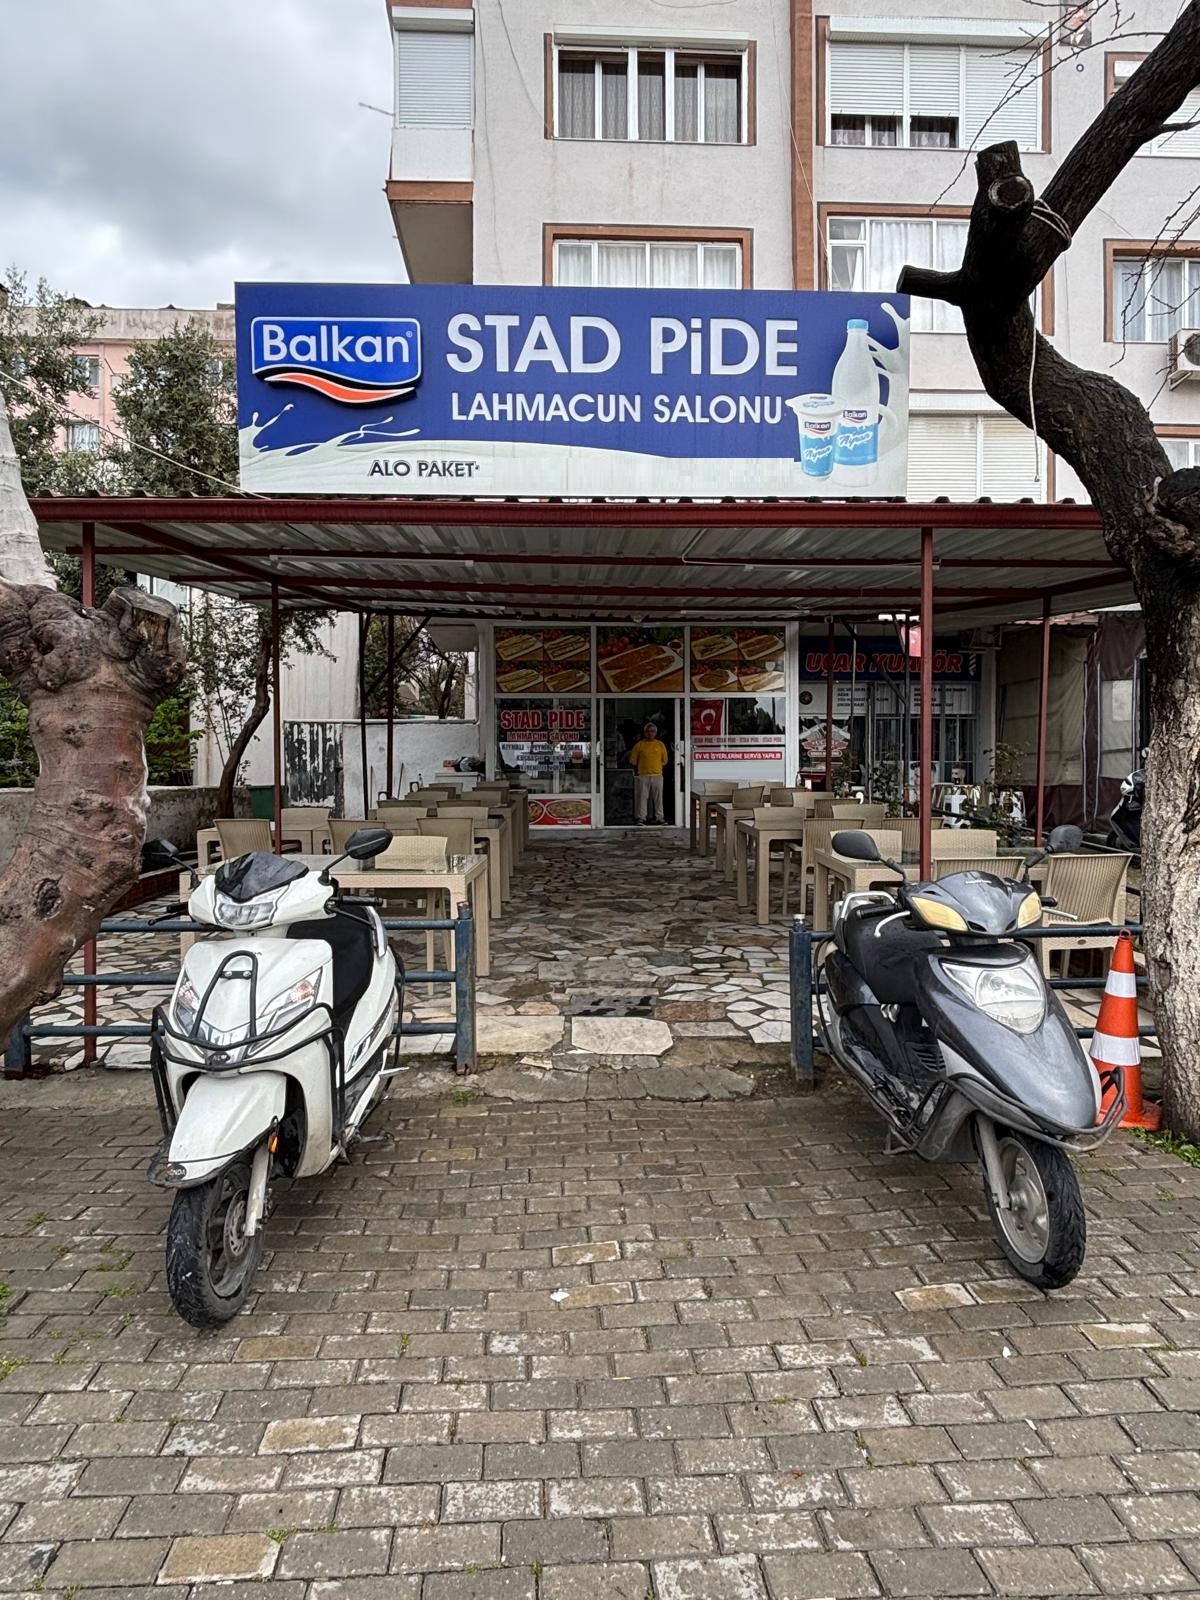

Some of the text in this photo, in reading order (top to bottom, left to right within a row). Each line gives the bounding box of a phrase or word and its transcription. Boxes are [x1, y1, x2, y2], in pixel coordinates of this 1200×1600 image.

[446, 313, 621, 373] STAD
[451, 392, 782, 424] LAHMACUN SALONU
[844, 410, 867, 418] Balkan
[368, 460, 411, 477] ALO
[805, 650, 963, 677] UÇAR KUAÖR
[500, 705, 585, 730] STAD PİDE
[549, 731, 580, 741] SALONU
